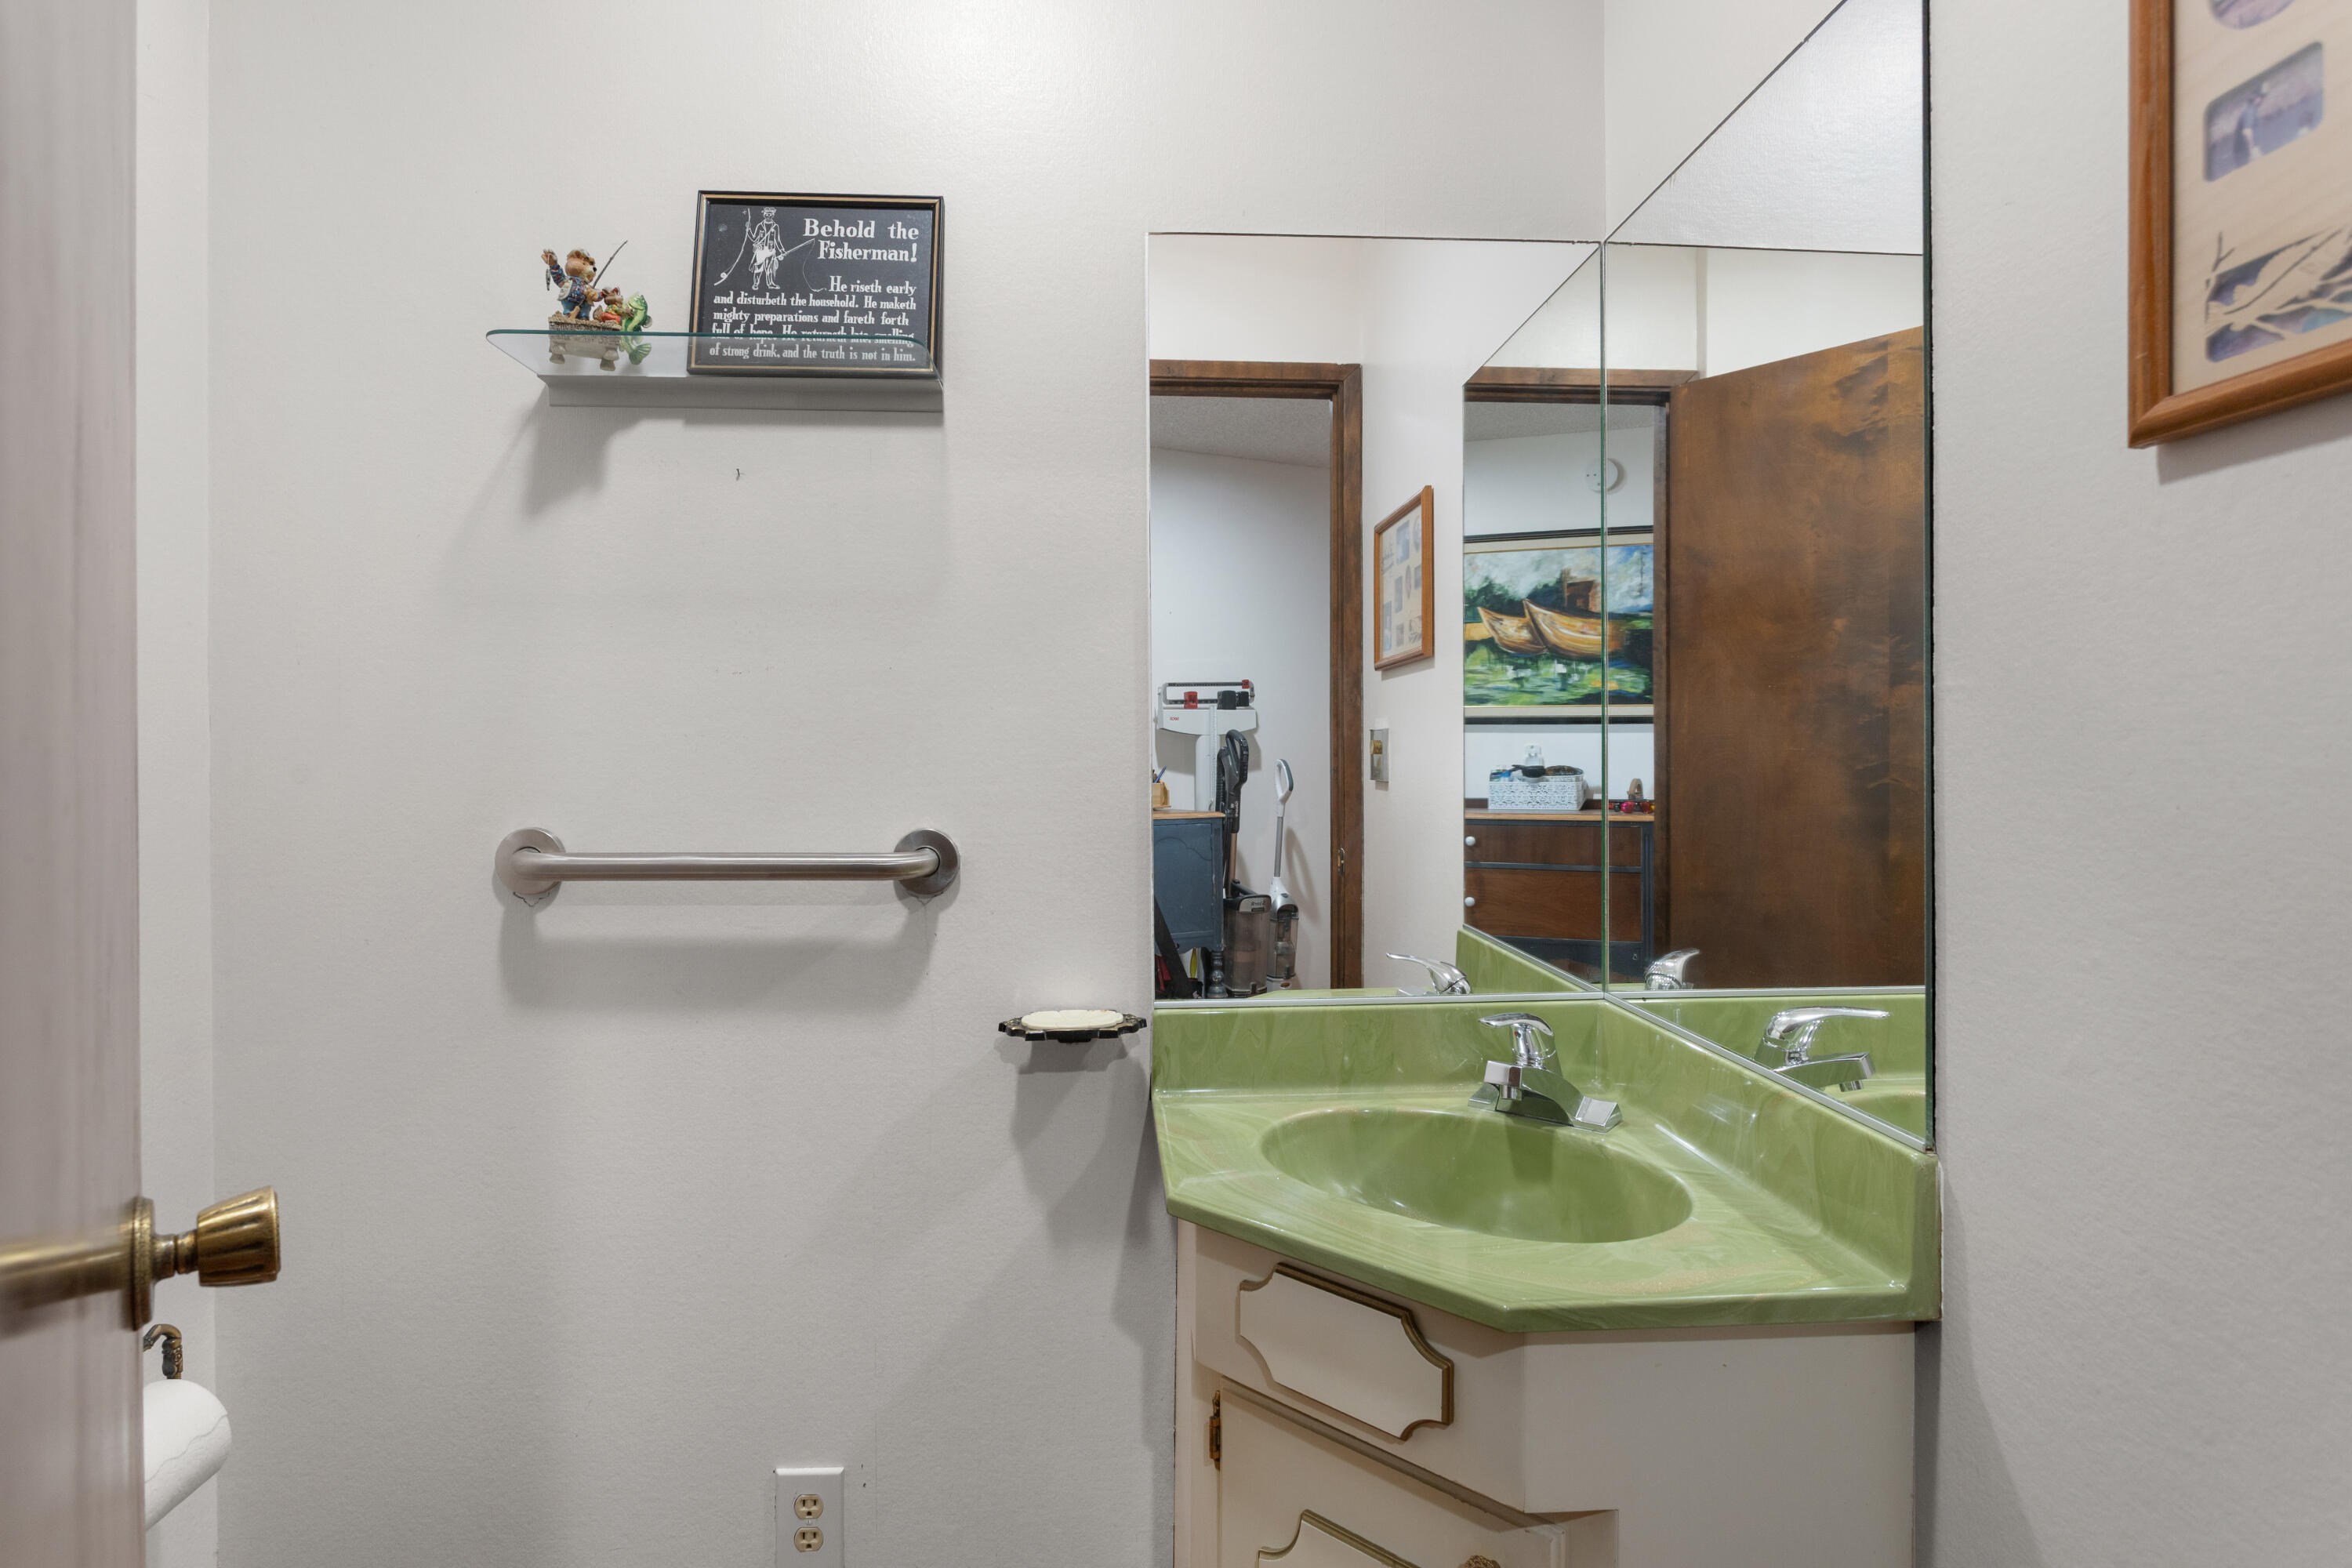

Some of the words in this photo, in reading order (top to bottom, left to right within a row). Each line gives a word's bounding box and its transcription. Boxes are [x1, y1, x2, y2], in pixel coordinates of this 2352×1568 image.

[803, 218, 875, 238] Behold
[887, 221, 920, 240] the
[817, 240, 918, 263] Fisherman!
[829, 275, 848, 292] He
[851, 279, 882, 293] riseth
[886, 281, 917, 296] early
[713, 291, 733, 305] and
[736, 292, 787, 306] disturbeth
[789, 292, 807, 307] the
[808, 293, 858, 308] household.
[863, 296, 878, 309] He
[880, 296, 916, 310] maketh
[713, 307, 750, 323] mighty
[753, 310, 818, 325] preparations
[822, 310, 840, 324] and
[844, 311, 876, 325] fareth
[880, 312, 909, 326] forth
[712, 322, 730, 339] full
[734, 324, 746, 339] of
[782, 324, 798, 341] He
[709, 342, 721, 356] of
[722, 346, 750, 359] strong
[753, 343, 781, 358] drink,
[782, 344, 799, 358] and
[802, 344, 818, 358] the
[821, 345, 845, 360] truth
[849, 346, 858, 360] is
[862, 350, 878, 361] not
[881, 347, 891, 361] in
[893, 347, 916, 361] him.
